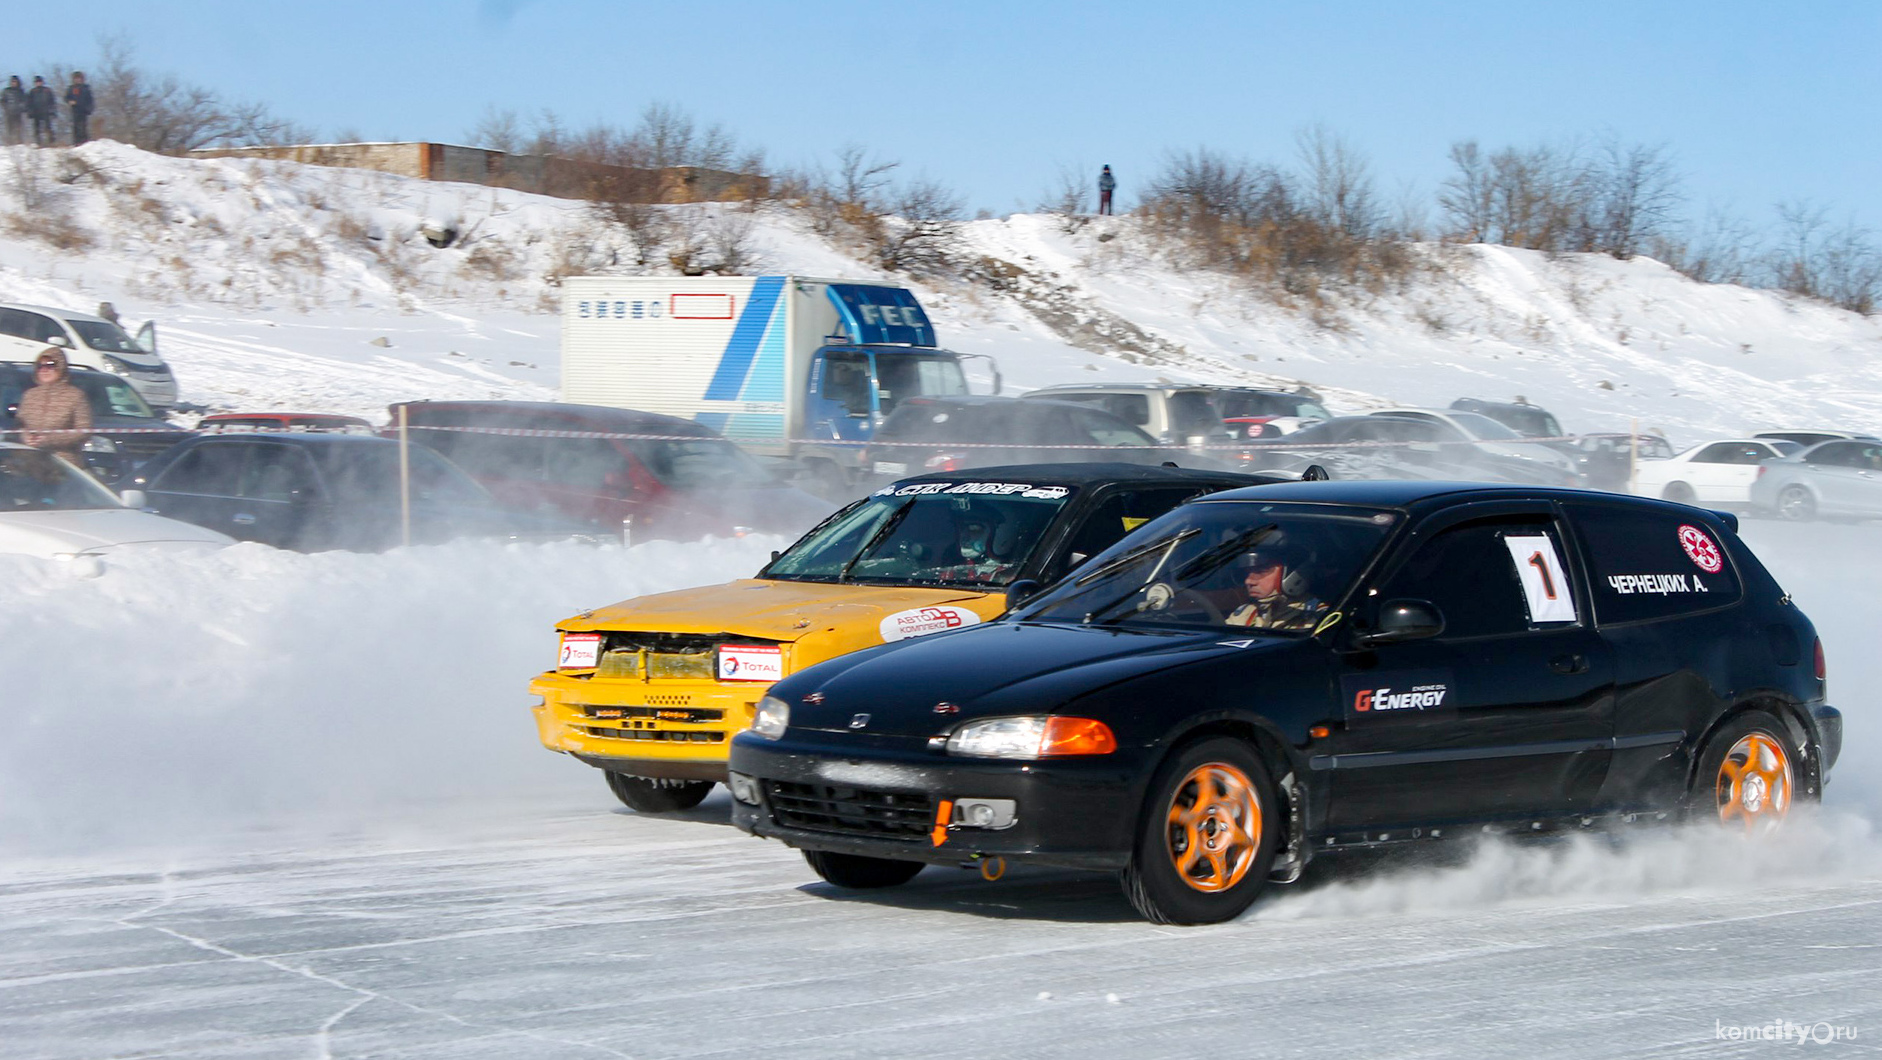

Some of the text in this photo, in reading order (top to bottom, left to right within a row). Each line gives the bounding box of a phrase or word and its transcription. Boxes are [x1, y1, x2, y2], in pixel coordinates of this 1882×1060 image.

[1528, 551, 1557, 600] 1
[1608, 574, 1690, 596] ЧЕРНЕЦКИХ
[897, 614, 933, 625] АВТО
[901, 621, 945, 634] КОМПЛЕКС
[573, 650, 594, 659] TOTAL
[742, 662, 779, 673] TOTAL
[1355, 688, 1446, 712] G-ENERGY
